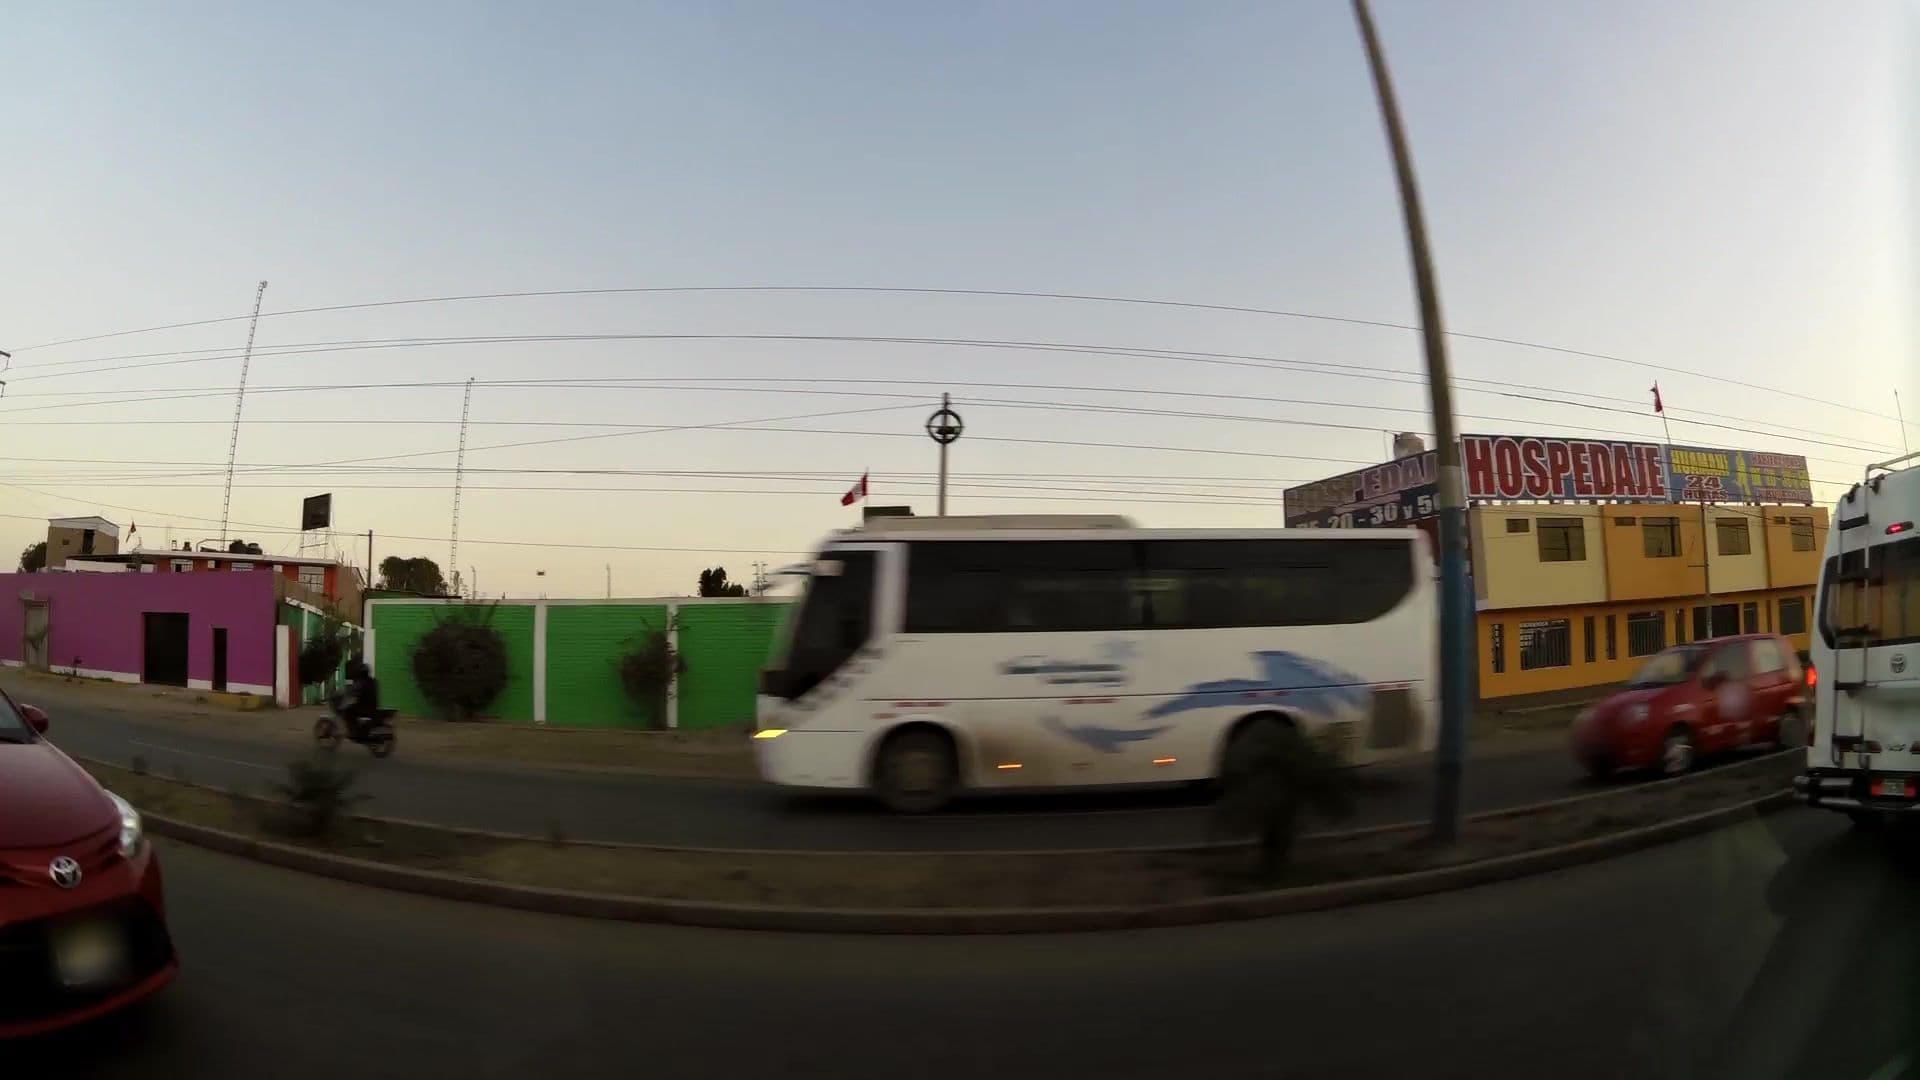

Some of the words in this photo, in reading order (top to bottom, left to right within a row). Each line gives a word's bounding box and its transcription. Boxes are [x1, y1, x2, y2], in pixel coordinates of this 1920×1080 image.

[1462, 436, 1666, 499] HOSPEDAJE
[1684, 474, 1723, 489] 24
[1328, 512, 1354, 529] 20
[1369, 503, 1398, 526] 30
